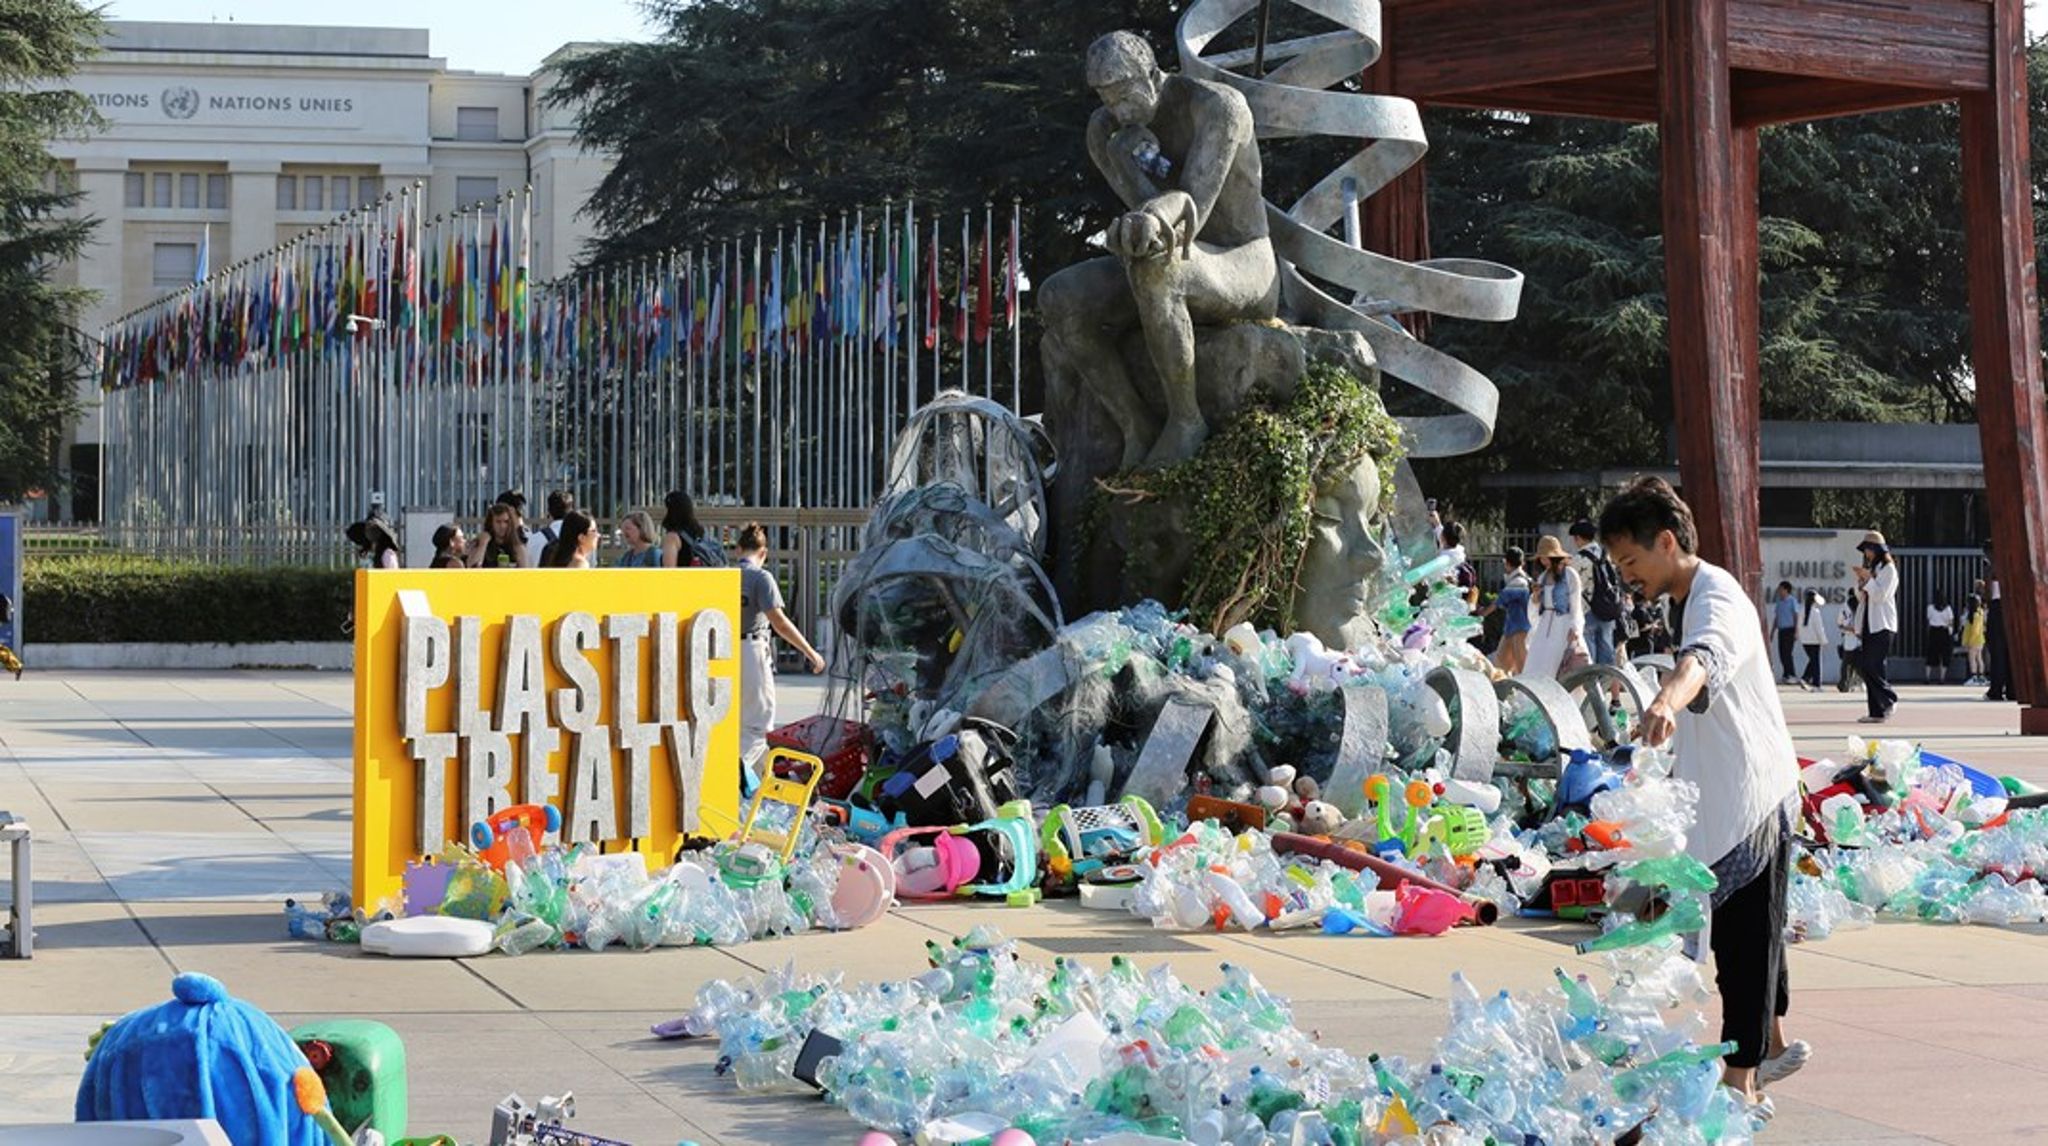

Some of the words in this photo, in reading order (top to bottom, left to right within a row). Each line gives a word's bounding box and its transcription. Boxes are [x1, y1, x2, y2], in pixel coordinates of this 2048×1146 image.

[88, 93, 150, 108] ATIONS
[209, 95, 293, 112] NATIONS
[299, 97, 354, 113] UNIES
[1779, 560, 1846, 580] UNIES
[400, 607, 733, 739] PLASTIC
[410, 718, 719, 856] TREATY
